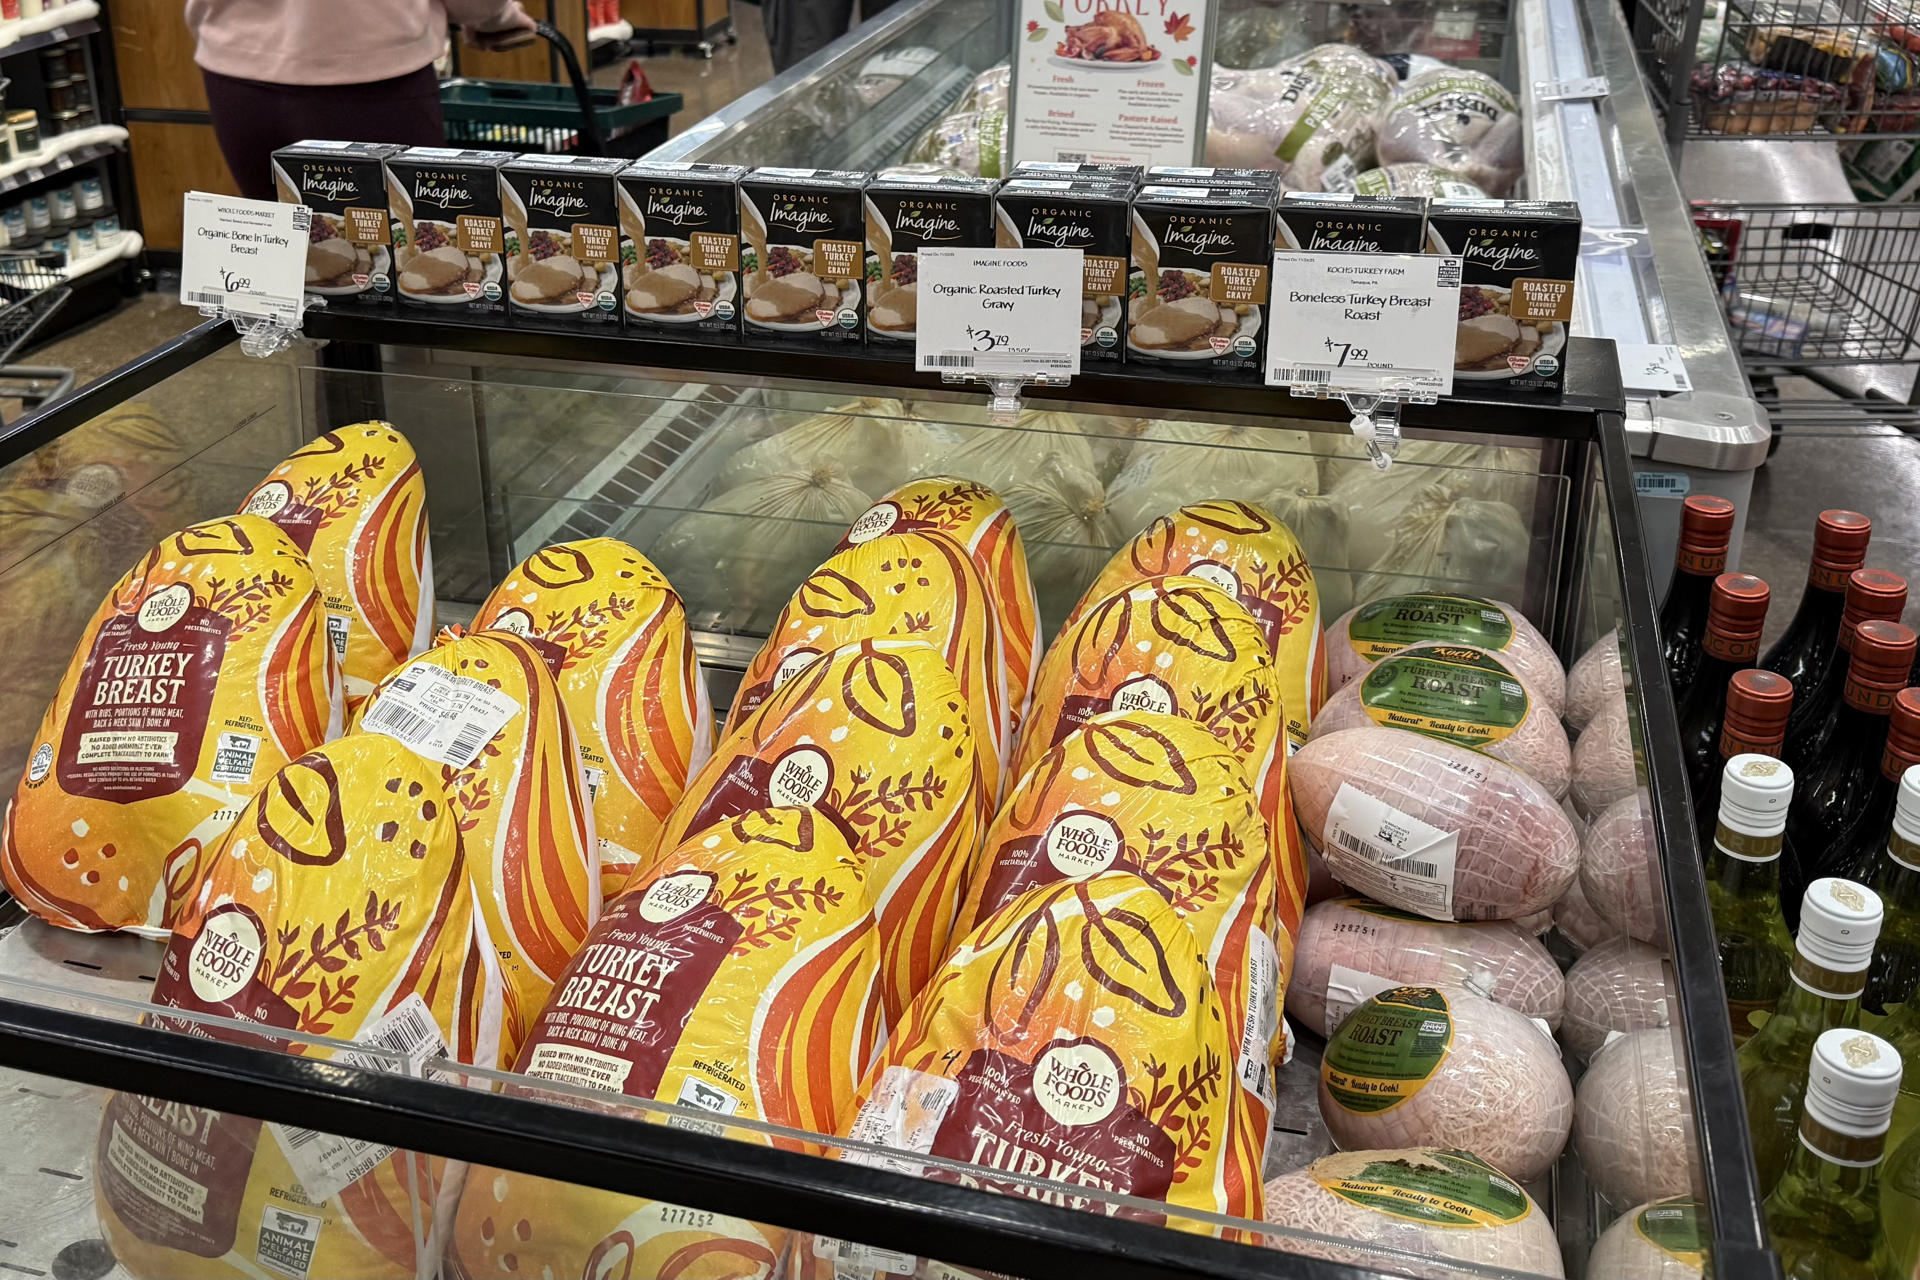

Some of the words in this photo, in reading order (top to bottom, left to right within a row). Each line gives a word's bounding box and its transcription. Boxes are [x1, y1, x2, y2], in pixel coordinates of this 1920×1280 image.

[1053, 75, 1074, 83] Fresh
[1118, 114, 1148, 123] Pasture
[303, 164, 354, 174] ORGANIC
[416, 171, 468, 181] ORGANIC
[531, 179, 584, 189] ORGANIC
[650, 188, 704, 197] ORGANIC
[773, 194, 829, 204] ORGANIC
[899, 200, 957, 211] ORGANIC
[352, 211, 383, 220] ROASTED
[1032, 207, 1092, 218] ORGANIC
[355, 219, 381, 228] TURKEY
[464, 219, 496, 229] ROASTED
[1170, 215, 1232, 226] ORGANIC
[1316, 221, 1382, 232] ORGANIC
[198, 227, 230, 240] Organic
[232, 231, 252, 241] Bone
[254, 233, 262, 242] In
[263, 234, 289, 248] Turkey
[467, 228, 494, 237] TURKEY
[579, 227, 612, 238] ROASTED
[1469, 228, 1539, 239] ORGANIC
[471, 241, 492, 249] GRAVY
[582, 236, 610, 246] TURKEY
[698, 236, 732, 246] ROASTED
[231, 244, 258, 255] Breast
[586, 250, 607, 258] GRAVY
[701, 245, 729, 254] TURKEY
[822, 243, 857, 254] ROASTED
[704, 259, 726, 267] GRAVY
[824, 252, 854, 261] TURKEY
[1083, 259, 1119, 269] ROASTED
[827, 267, 850, 275] GRAVY
[1085, 268, 1116, 278] TURKEY
[1221, 267, 1260, 277] ROASTED
[1354, 267, 1383, 275] TURKEY
[1087, 283, 1112, 291] GRAVY
[1223, 276, 1257, 286] TURKEY
[933, 284, 977, 296] Organic
[980, 285, 1024, 295] Roasted
[1025, 286, 1061, 298] Turkey
[1522, 283, 1567, 294] ROASTED
[1226, 291, 1252, 300] GRAVY
[1290, 292, 1346, 304] Boneless
[1347, 294, 1387, 308] Turkey
[1390, 295, 1433, 307] Breast
[1525, 292, 1563, 303] TURKEY
[982, 299, 1014, 311] Gravy
[1344, 309, 1382, 320] Roast
[1527, 307, 1556, 317] GRAVY
[855, 511, 893, 527] WHOLE
[853, 520, 889, 533] FOODS
[149, 596, 185, 609] WHOLE
[145, 606, 181, 618] FOODS
[1394, 608, 1464, 625] ROAST
[123, 642, 148, 651] Fresh
[150, 641, 180, 650] Young
[101, 653, 194, 679] TURKEY
[1402, 666, 1449, 680] TURKEY
[1454, 674, 1499, 687] BREAST
[93, 679, 185, 706] BREAST
[1411, 677, 1484, 699] ROAST
[1122, 691, 1167, 713] WHOLE
[85, 710, 98, 719] WITH
[114, 708, 141, 717] PORTIONS
[151, 708, 166, 717] WING
[146, 719, 163, 727] BONE
[1429, 721, 1455, 733] Ready
[1467, 726, 1490, 735] Cook!
[219, 751, 254, 760] ANIMAL
[786, 760, 822, 791] WHOLE
[777, 773, 813, 803] FOODS
[1061, 825, 1113, 852] WHOLE
[1011, 849, 1029, 859] 100%
[1055, 838, 1108, 863] FOODS
[1057, 852, 1095, 867] MARKET
[658, 881, 705, 900] WHOLE
[650, 890, 695, 909] FOODS
[648, 902, 678, 914] MARKET
[608, 928, 636, 941] Fresh
[1332, 923, 1376, 937] 328251
[205, 929, 255, 968] WHOLE
[196, 946, 245, 983] FOODS
[576, 944, 680, 990] TURKEY
[1250, 957, 1258, 985] BREAST
[195, 969, 228, 989] MARKET
[556, 976, 661, 1024] BREAST
[1249, 985, 1258, 1014] TURKEY
[254, 1005, 268, 1020] NO
[571, 1013, 600, 1030] PORTIONS
[609, 1021, 627, 1037] WING
[627, 1026, 646, 1044] MEAT,
[1245, 1015, 1254, 1038] FRESH
[565, 1029, 580, 1042] NECK
[580, 1031, 597, 1044] SKIN
[601, 1035, 618, 1049] BONE
[1349, 1024, 1403, 1046] ROAST
[1242, 1038, 1252, 1056] WFM
[558, 1052, 573, 1061] WITH
[585, 1056, 619, 1073] ANTIBIOTICS
[941, 1050, 962, 1076] 4
[591, 1069, 612, 1082] EVER
[693, 1060, 746, 1092] REFRIGERATED
[984, 1065, 1010, 1089] 100%
[1049, 1055, 1112, 1091] WHOLE
[1043, 1071, 1107, 1109] FOODS
[1351, 1079, 1370, 1093] Ready
[1371, 1083, 1377, 1092] to
[1380, 1083, 1399, 1093] Cook!
[1046, 1090, 1093, 1113] MARKET
[1005, 1119, 1050, 1148] Fresh
[1054, 1139, 1110, 1172] Young
[1135, 1132, 1150, 1146] NO
[1113, 1134, 1165, 1168] PRESERVATIVES
[1392, 1188, 1428, 1204] Ready
[1443, 1201, 1473, 1217] Cook!
[660, 1206, 714, 1228] 277252
[262, 1232, 310, 1252] ANIMAL
[261, 1240, 309, 1262] WELFARE
[260, 1247, 306, 1270] CERTIFIED
